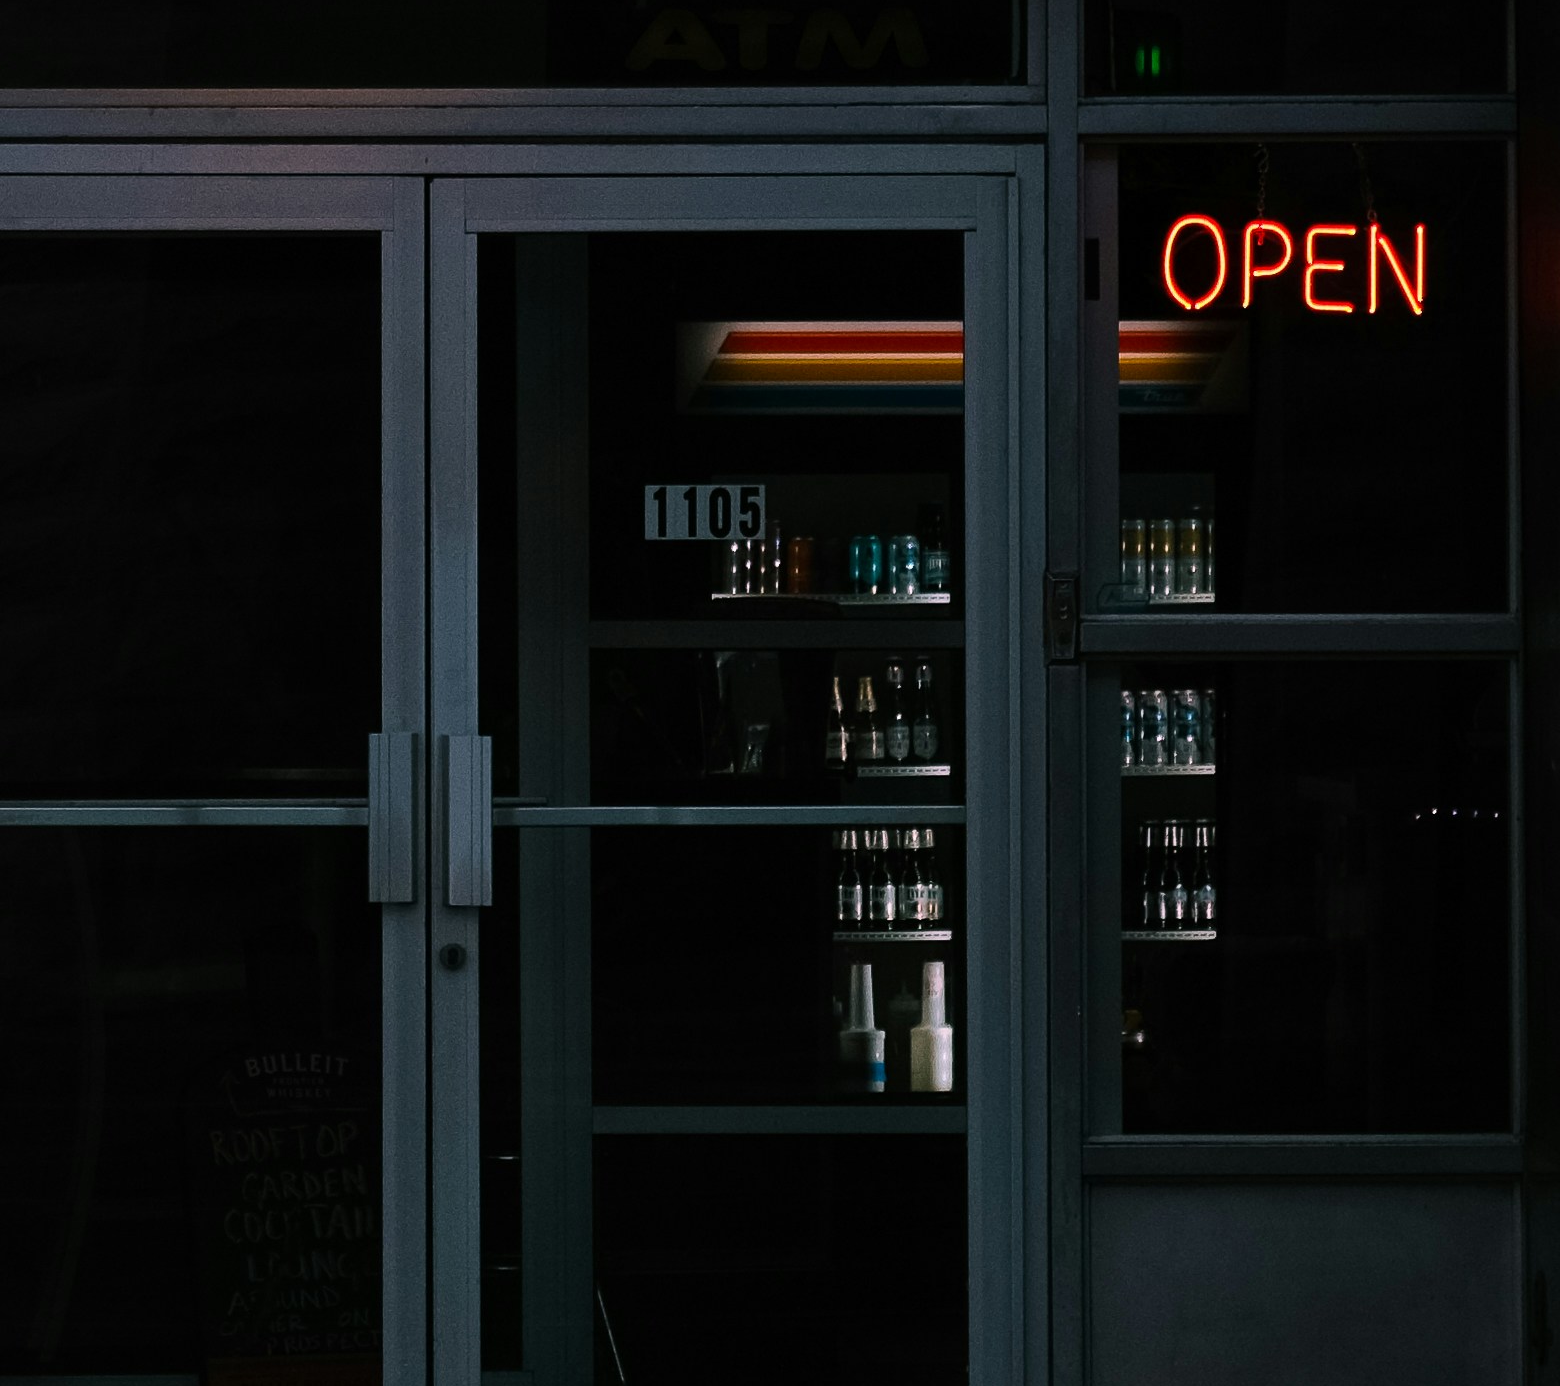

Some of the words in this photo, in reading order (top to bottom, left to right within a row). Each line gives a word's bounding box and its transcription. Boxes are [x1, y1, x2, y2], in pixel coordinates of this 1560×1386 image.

[624, 7, 930, 71] ATM
[1162, 213, 1429, 315] OPEN
[653, 486, 762, 537] 1105
[244, 1052, 349, 1078] BULLEIT
[265, 1087, 332, 1099] WHISKEY
[242, 1164, 368, 1210] GARDEN
[337, 1308, 370, 1327] ON
